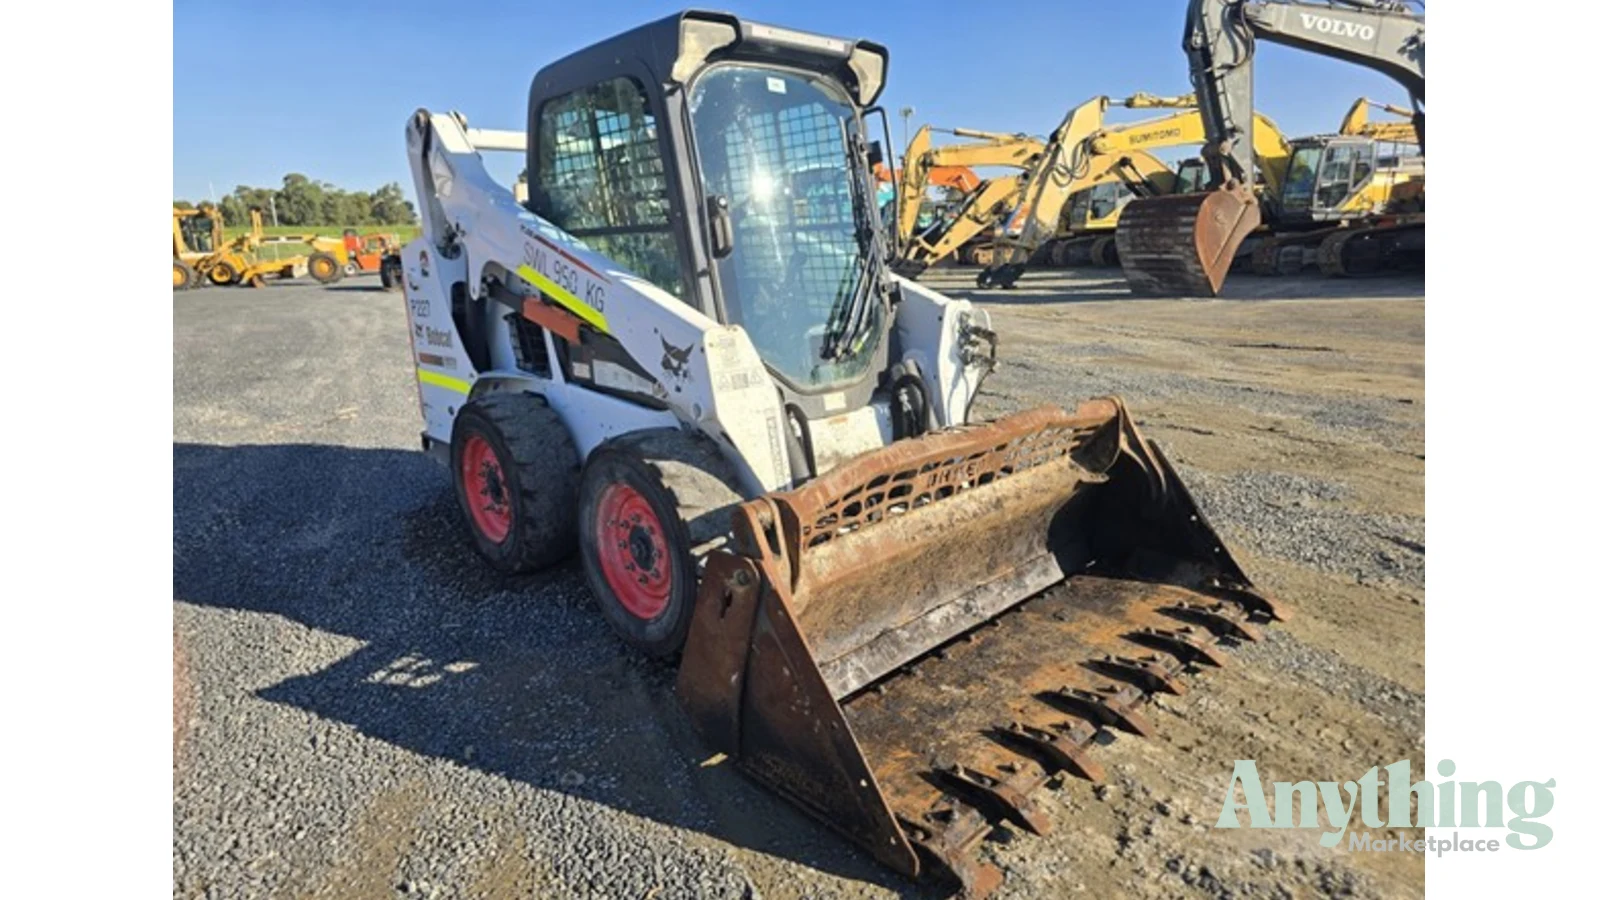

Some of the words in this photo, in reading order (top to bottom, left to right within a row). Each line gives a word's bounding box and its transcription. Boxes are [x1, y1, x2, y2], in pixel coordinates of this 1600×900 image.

[1300, 13, 1375, 41] VOLVO
[1128, 128, 1181, 145] SUMITOMO
[523, 241, 550, 278] SWL
[554, 260, 578, 295] 950
[585, 279, 606, 313] KG
